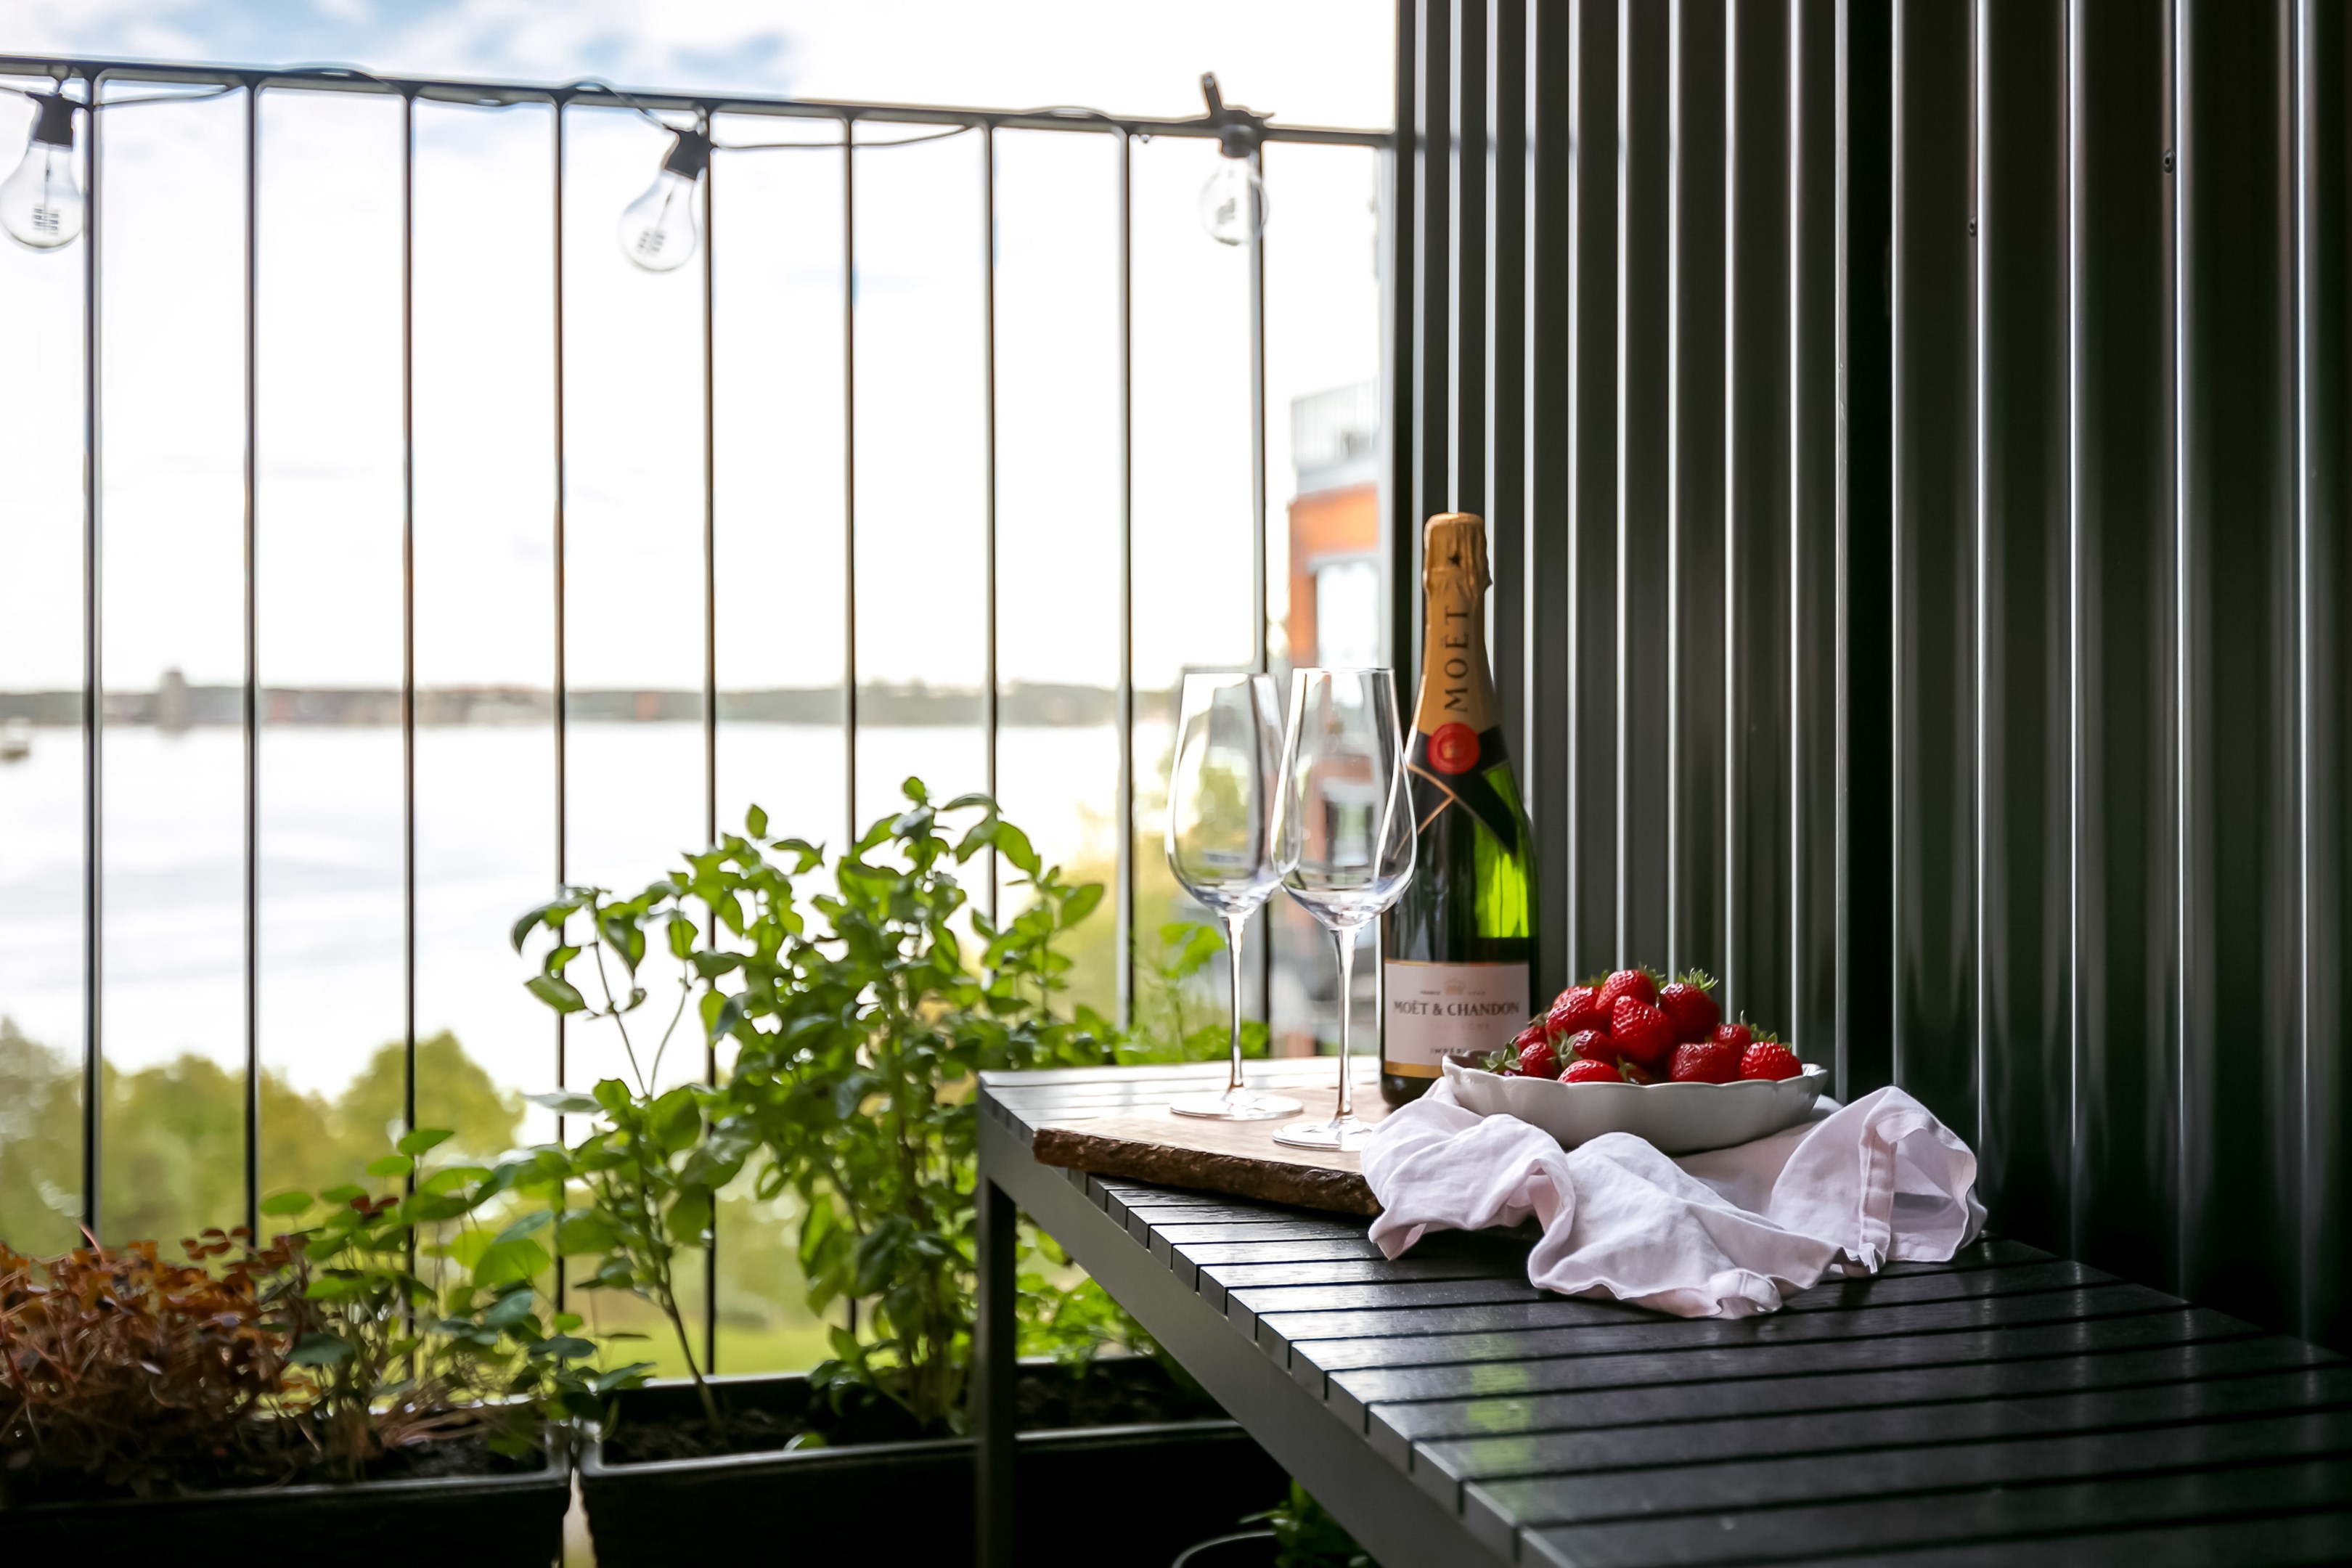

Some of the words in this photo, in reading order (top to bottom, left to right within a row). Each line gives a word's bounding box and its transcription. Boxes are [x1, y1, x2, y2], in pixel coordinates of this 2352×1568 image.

[1441, 605, 1469, 713] MOËT
[1394, 1000, 1429, 1016] MOËT
[1432, 1003, 1443, 1016] &
[1447, 1001, 1520, 1016] CHANDON
